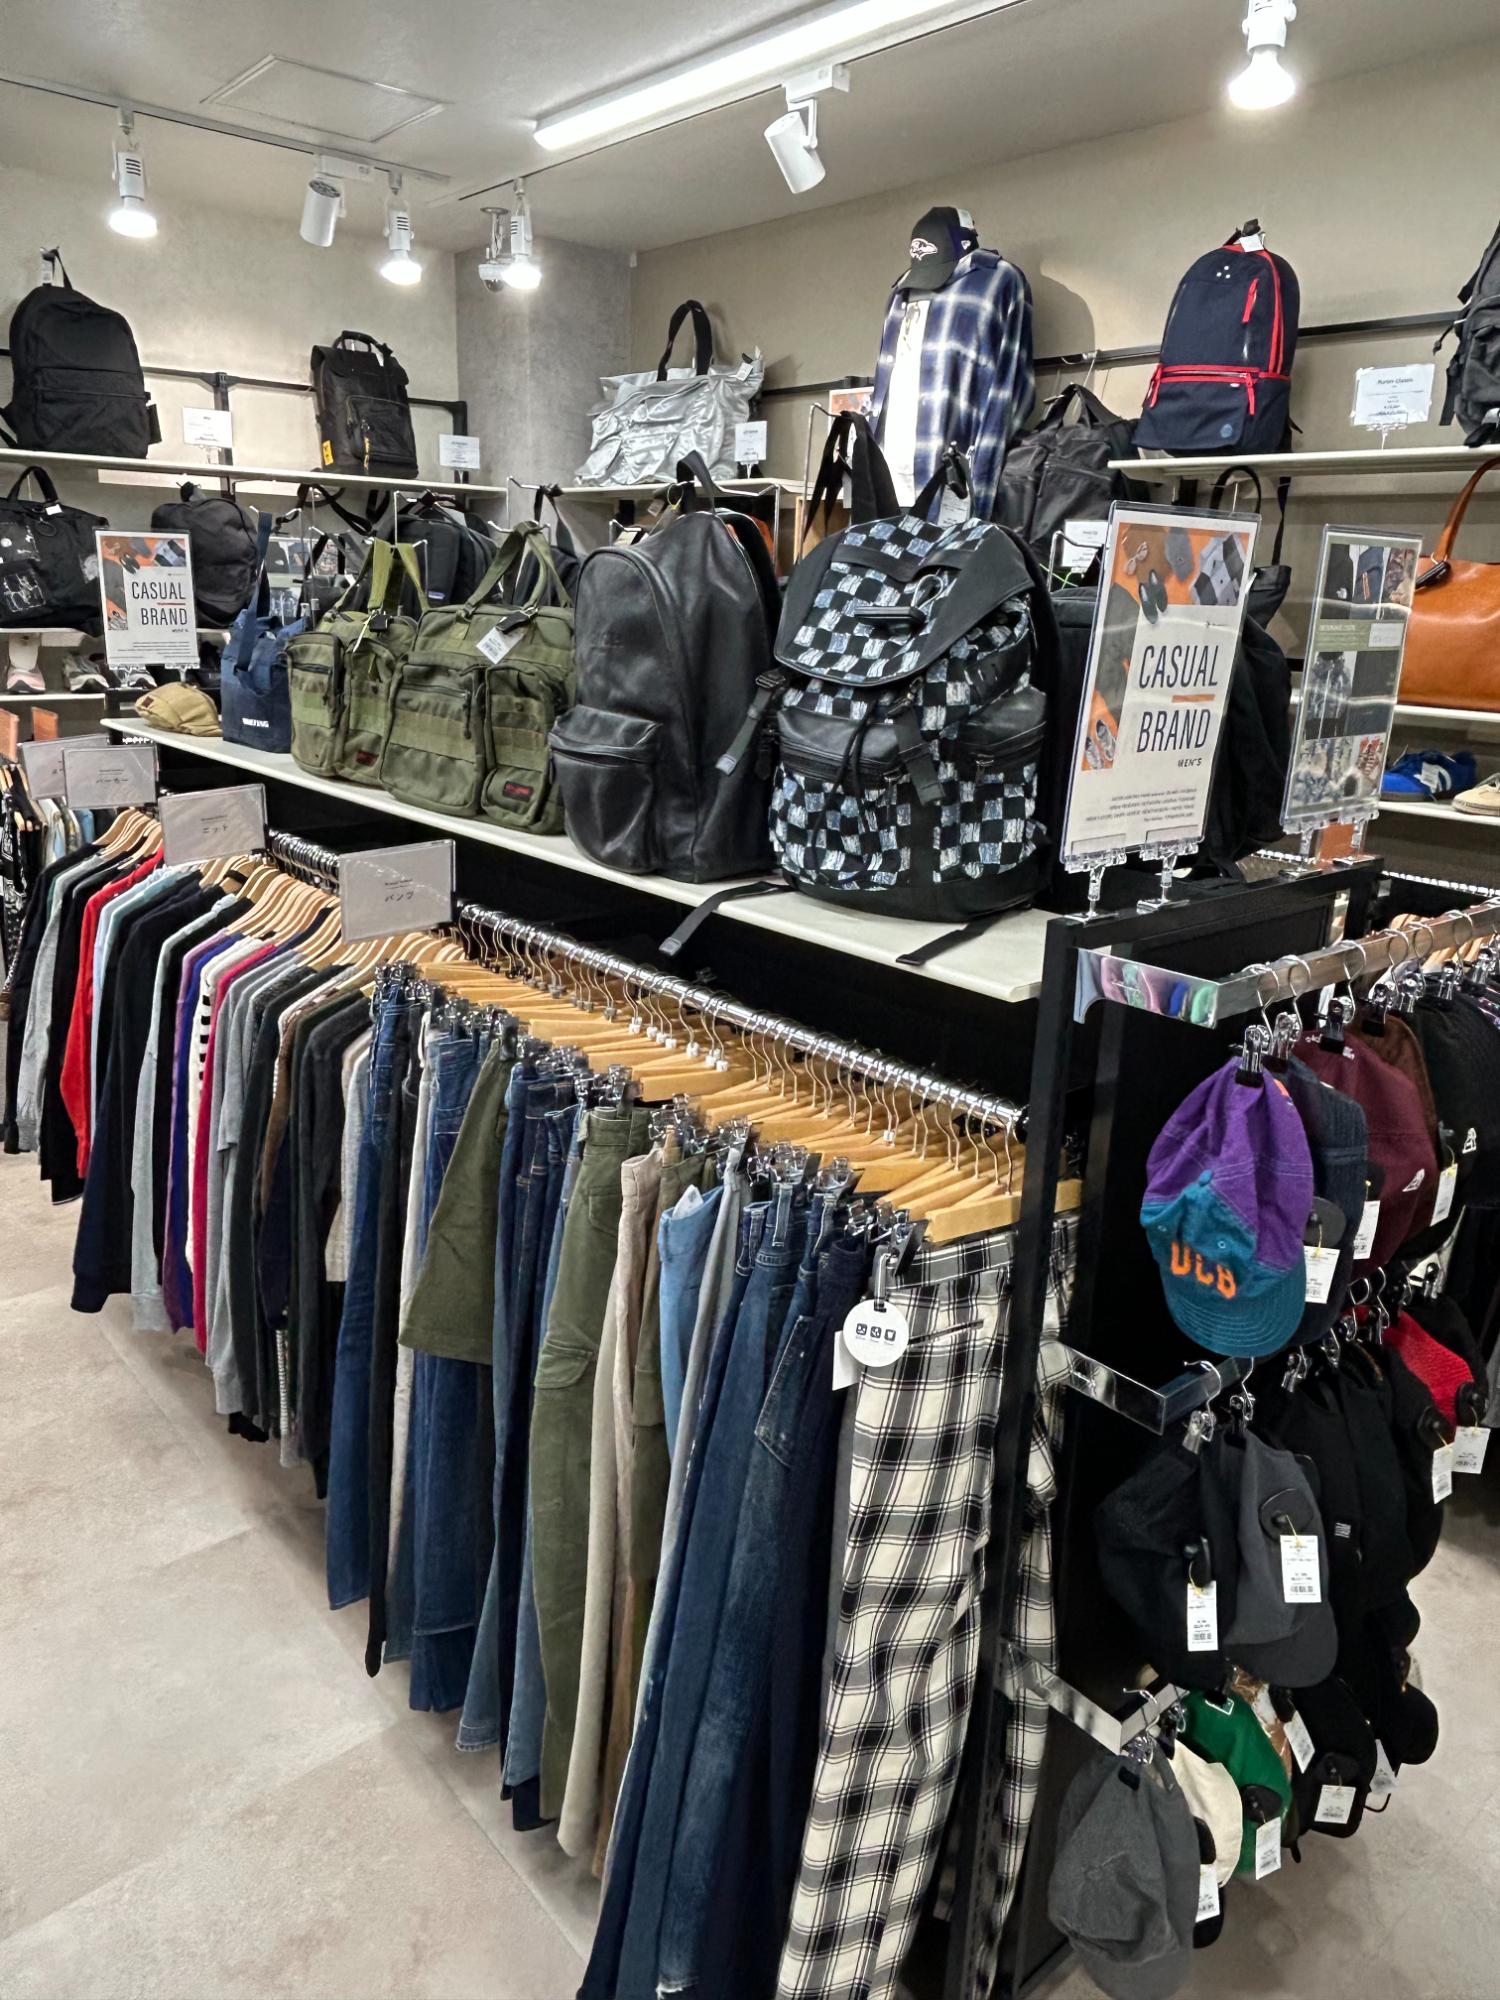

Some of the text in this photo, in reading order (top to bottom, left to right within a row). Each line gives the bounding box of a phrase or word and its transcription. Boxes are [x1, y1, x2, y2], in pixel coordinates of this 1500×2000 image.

[131, 581, 187, 600] CASUAL
[141, 608, 188, 625] BRAND
[1139, 645, 1219, 689] CASUAL
[1136, 709, 1211, 753] BRAND
